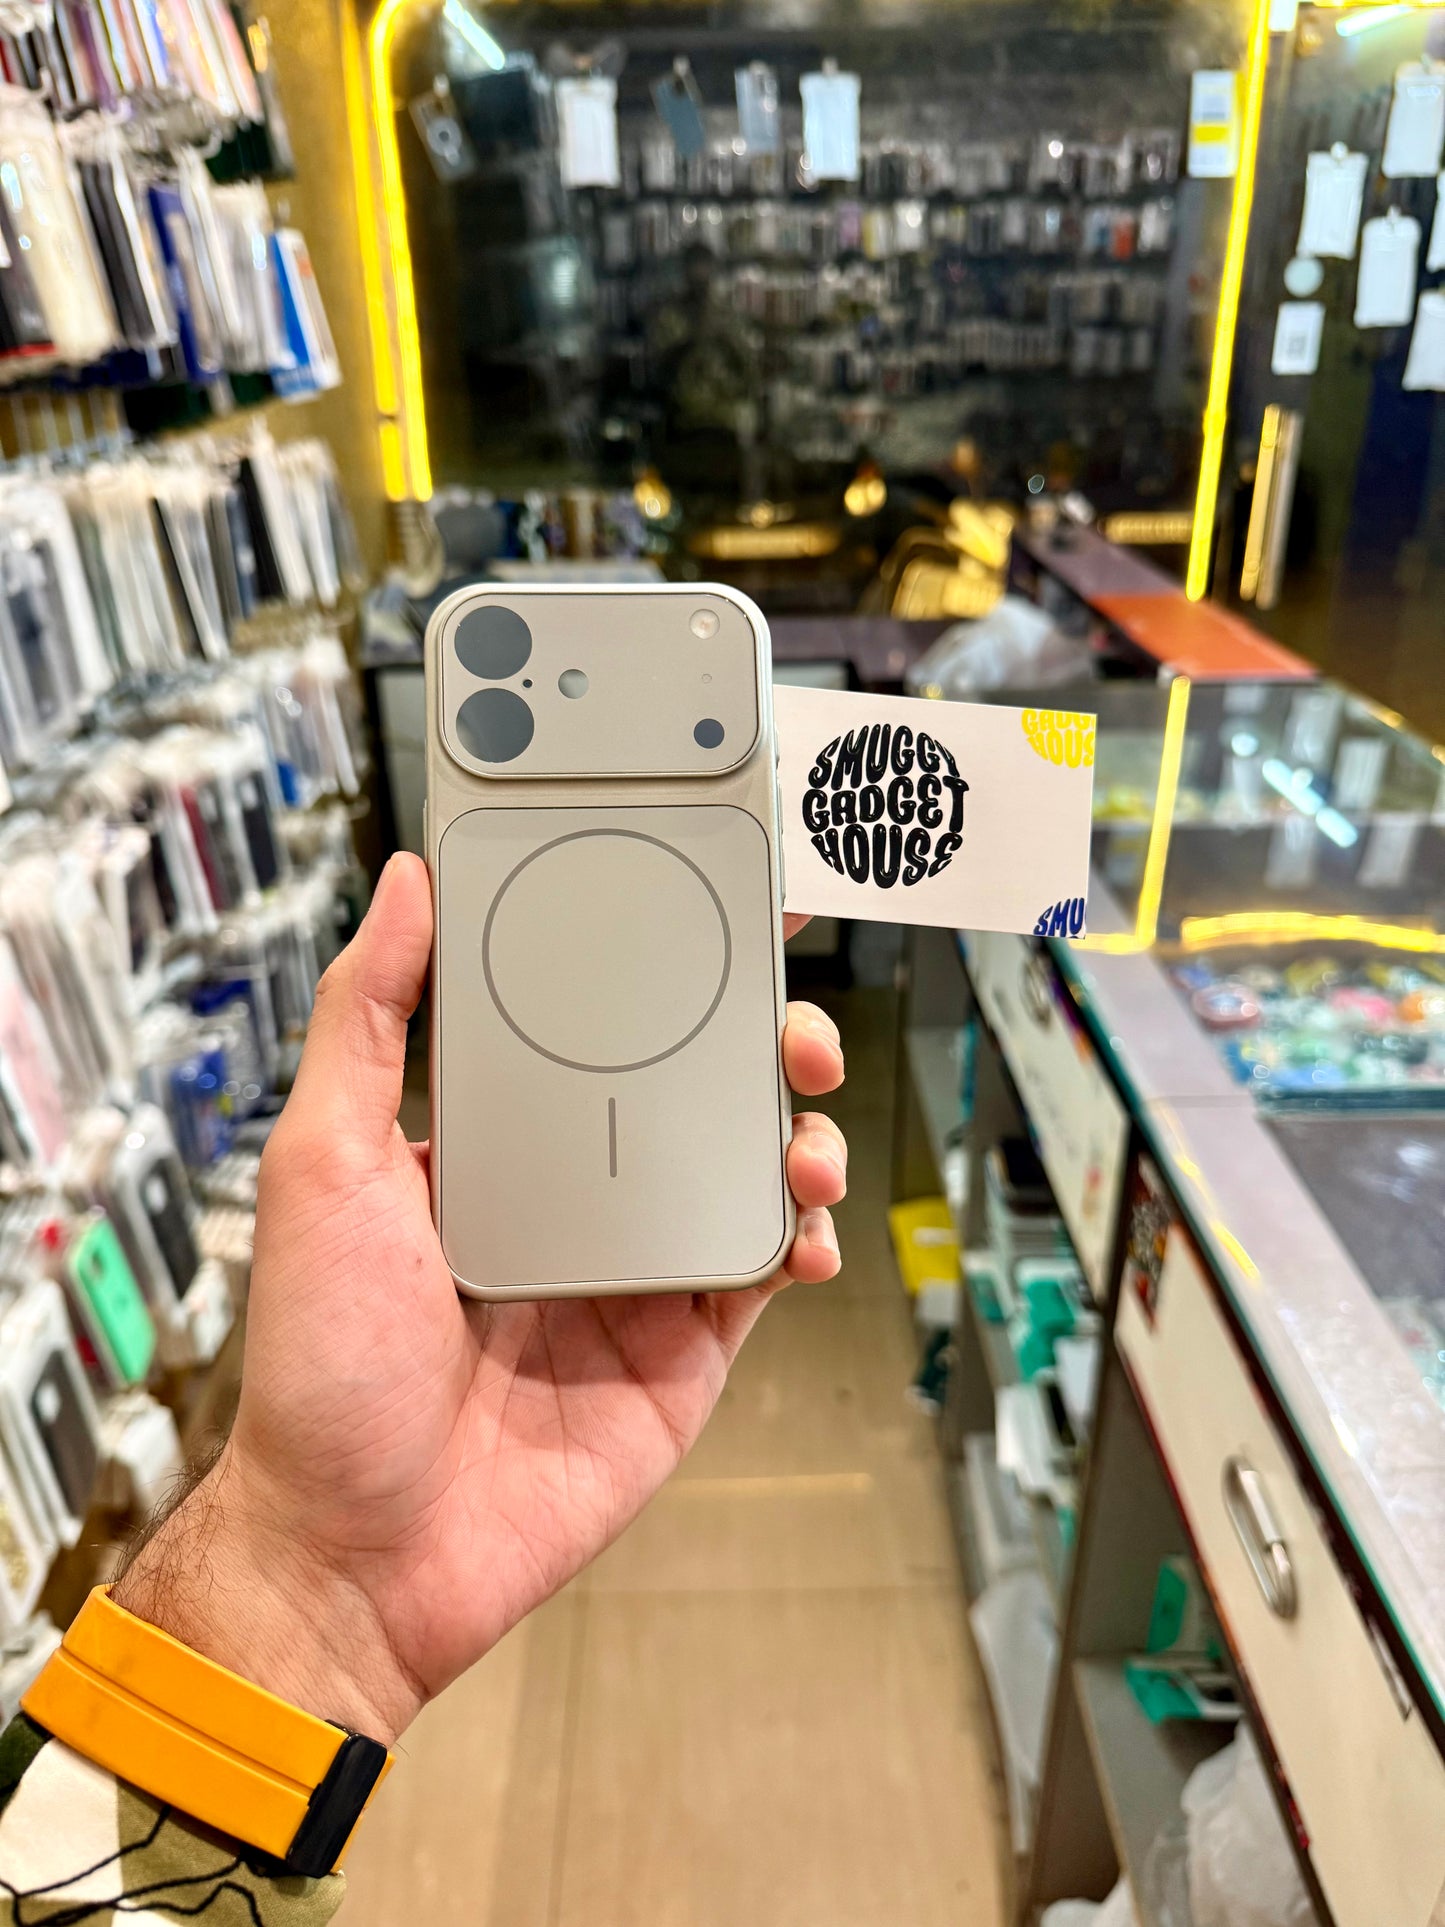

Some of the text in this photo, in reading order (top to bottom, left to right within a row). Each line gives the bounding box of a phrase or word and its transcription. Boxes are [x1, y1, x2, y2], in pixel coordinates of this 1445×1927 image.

[1021, 707, 1096, 736] GADG
[808, 724, 960, 790] SMUGGY
[802, 774, 969, 833] GADGET
[811, 823, 962, 888] HOUSE
[1033, 897, 1085, 937] SMU
